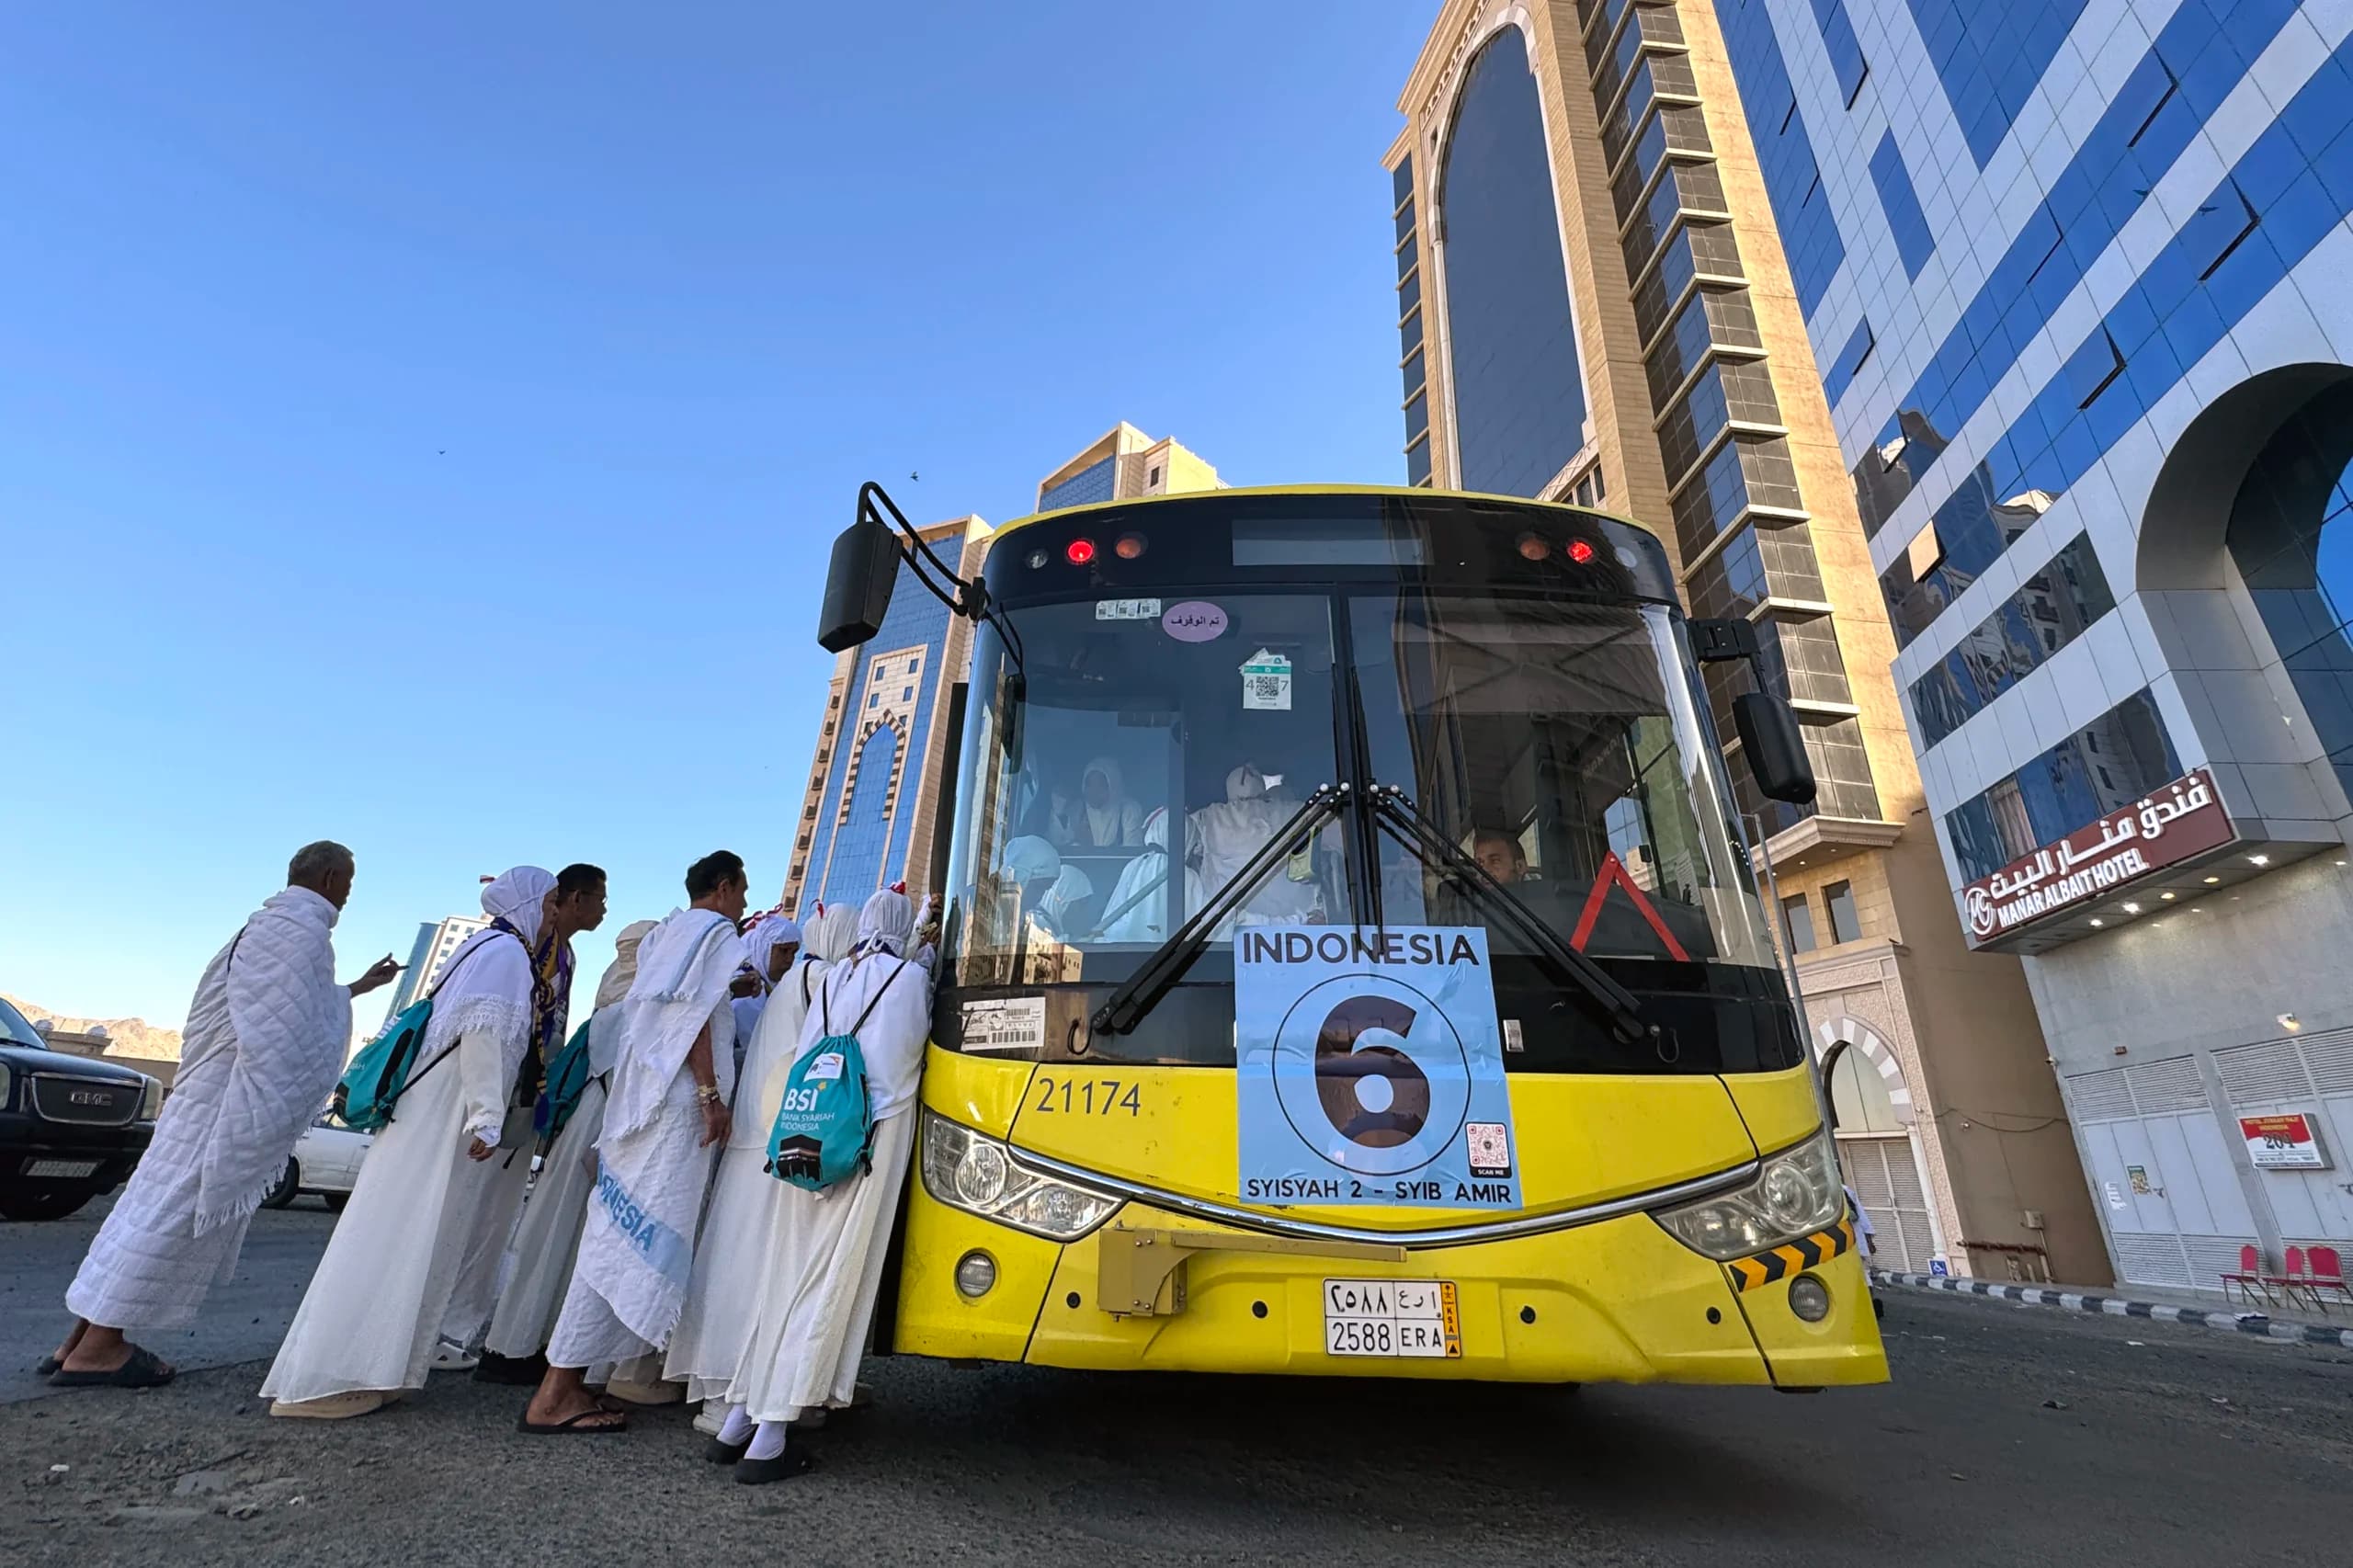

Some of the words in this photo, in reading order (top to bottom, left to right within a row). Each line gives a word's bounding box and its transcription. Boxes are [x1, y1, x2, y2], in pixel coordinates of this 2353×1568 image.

[1245, 679, 1255, 690] 4
[1280, 680, 1289, 691] 7
[2137, 777, 2212, 840] فندق
[1990, 849, 2056, 899] البيت
[1997, 892, 2046, 927] MANAR
[2090, 847, 2150, 888] HOTEL
[1243, 932, 1480, 966] INDONESIA
[1314, 995, 1431, 1149] 6
[784, 1088, 819, 1111] BSI
[1036, 1077, 1142, 1117] 21174
[1247, 1178, 1339, 1199] SYISYAH
[1350, 1180, 1362, 1199] 2
[1395, 1181, 1442, 1200] SYIB
[1454, 1183, 1512, 1203] AMIR
[1333, 1322, 1391, 1352] 2588
[1401, 1327, 1442, 1347] ERA
